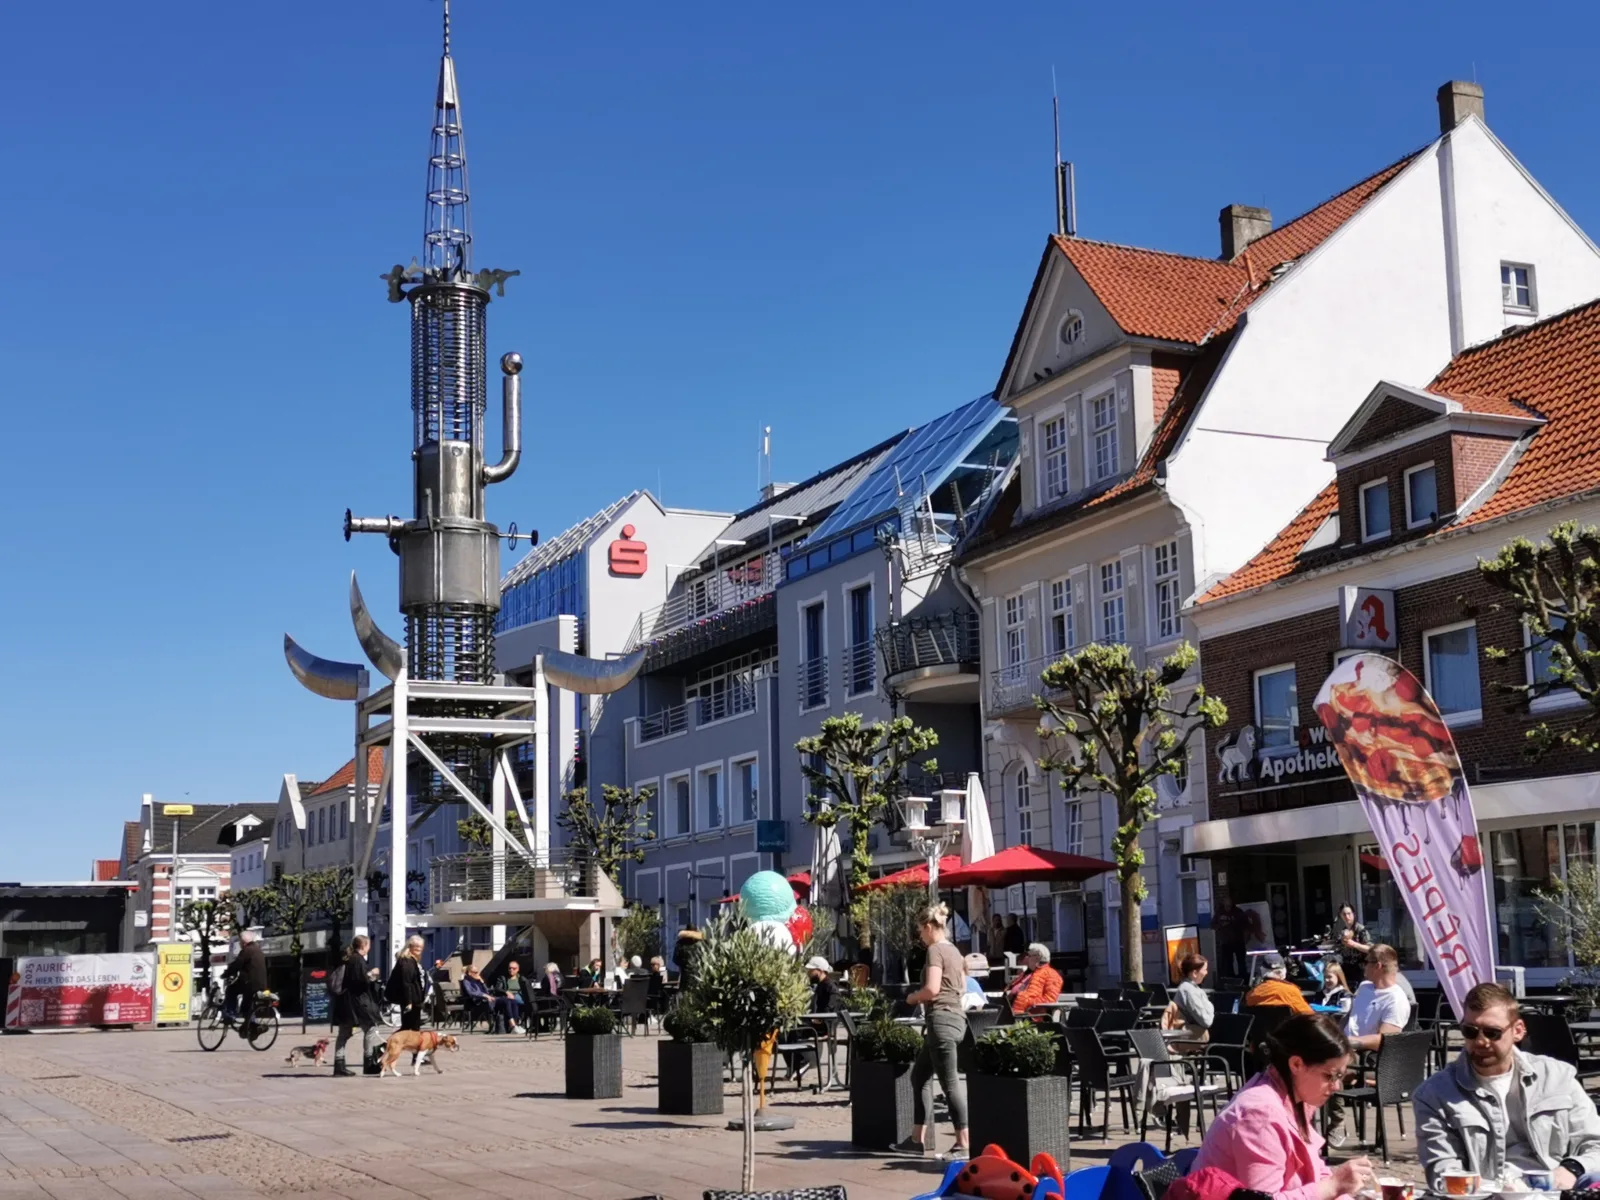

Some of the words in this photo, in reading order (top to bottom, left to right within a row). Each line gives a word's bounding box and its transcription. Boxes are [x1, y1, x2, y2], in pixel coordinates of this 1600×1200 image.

[1260, 746, 1342, 783] Apothek
[25, 963, 34, 984] 2025
[35, 976, 53, 985] HIER
[76, 974, 89, 983] DAS
